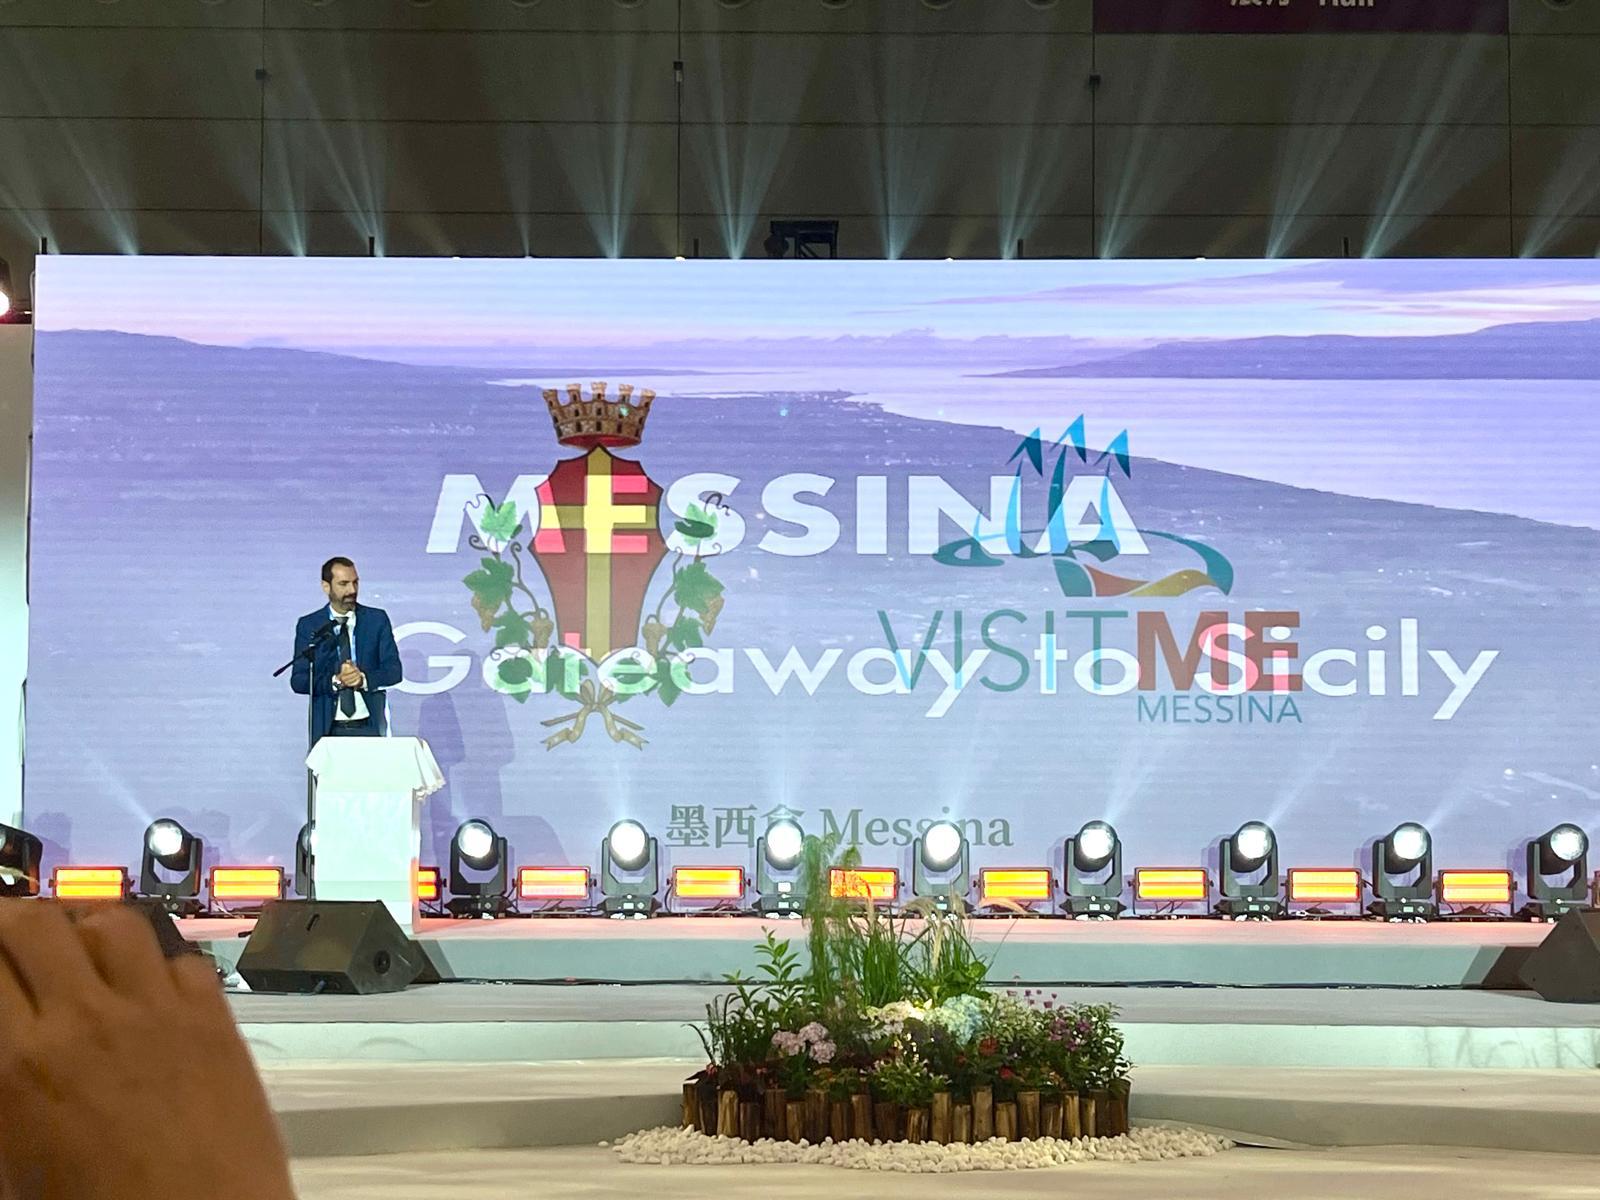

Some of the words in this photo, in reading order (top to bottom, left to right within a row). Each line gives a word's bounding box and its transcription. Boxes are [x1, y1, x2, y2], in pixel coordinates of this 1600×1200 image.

[427, 473, 1149, 557] MESSINA
[393, 621, 991, 718] Gateaway
[1035, 633, 1141, 695] to
[1195, 618, 1500, 720] Sicily
[1138, 694, 1303, 724] MESSINA
[819, 806, 1014, 846] Mesna
